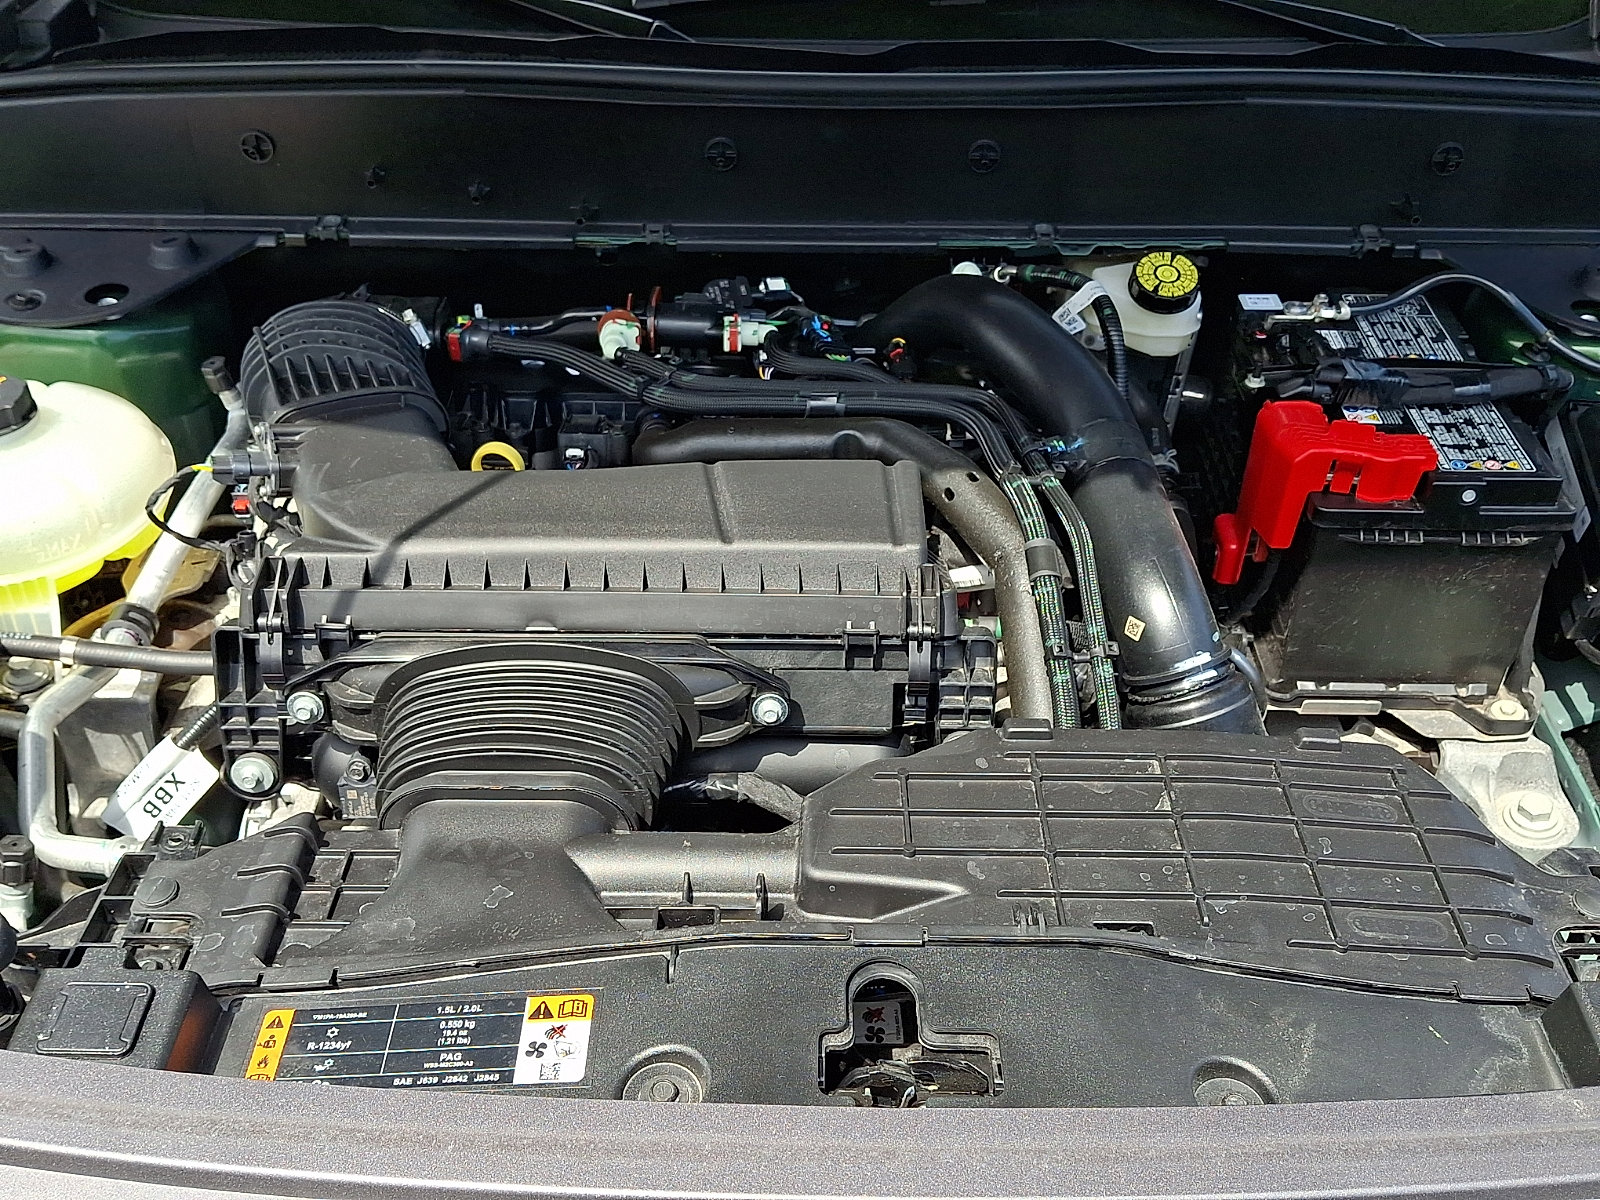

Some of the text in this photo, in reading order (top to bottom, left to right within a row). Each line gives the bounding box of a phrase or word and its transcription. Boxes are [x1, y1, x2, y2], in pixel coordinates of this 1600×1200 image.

[143, 772, 186, 818] XBB
[437, 1006, 456, 1014] 1.5L
[462, 1005, 483, 1013] 2.0L
[439, 1020, 476, 1029] 0.550 kg
[306, 1040, 352, 1051] R-1234yf
[439, 1053, 462, 1061] PAG
[393, 1077, 413, 1086] SAE
[417, 1076, 439, 1085] J639
